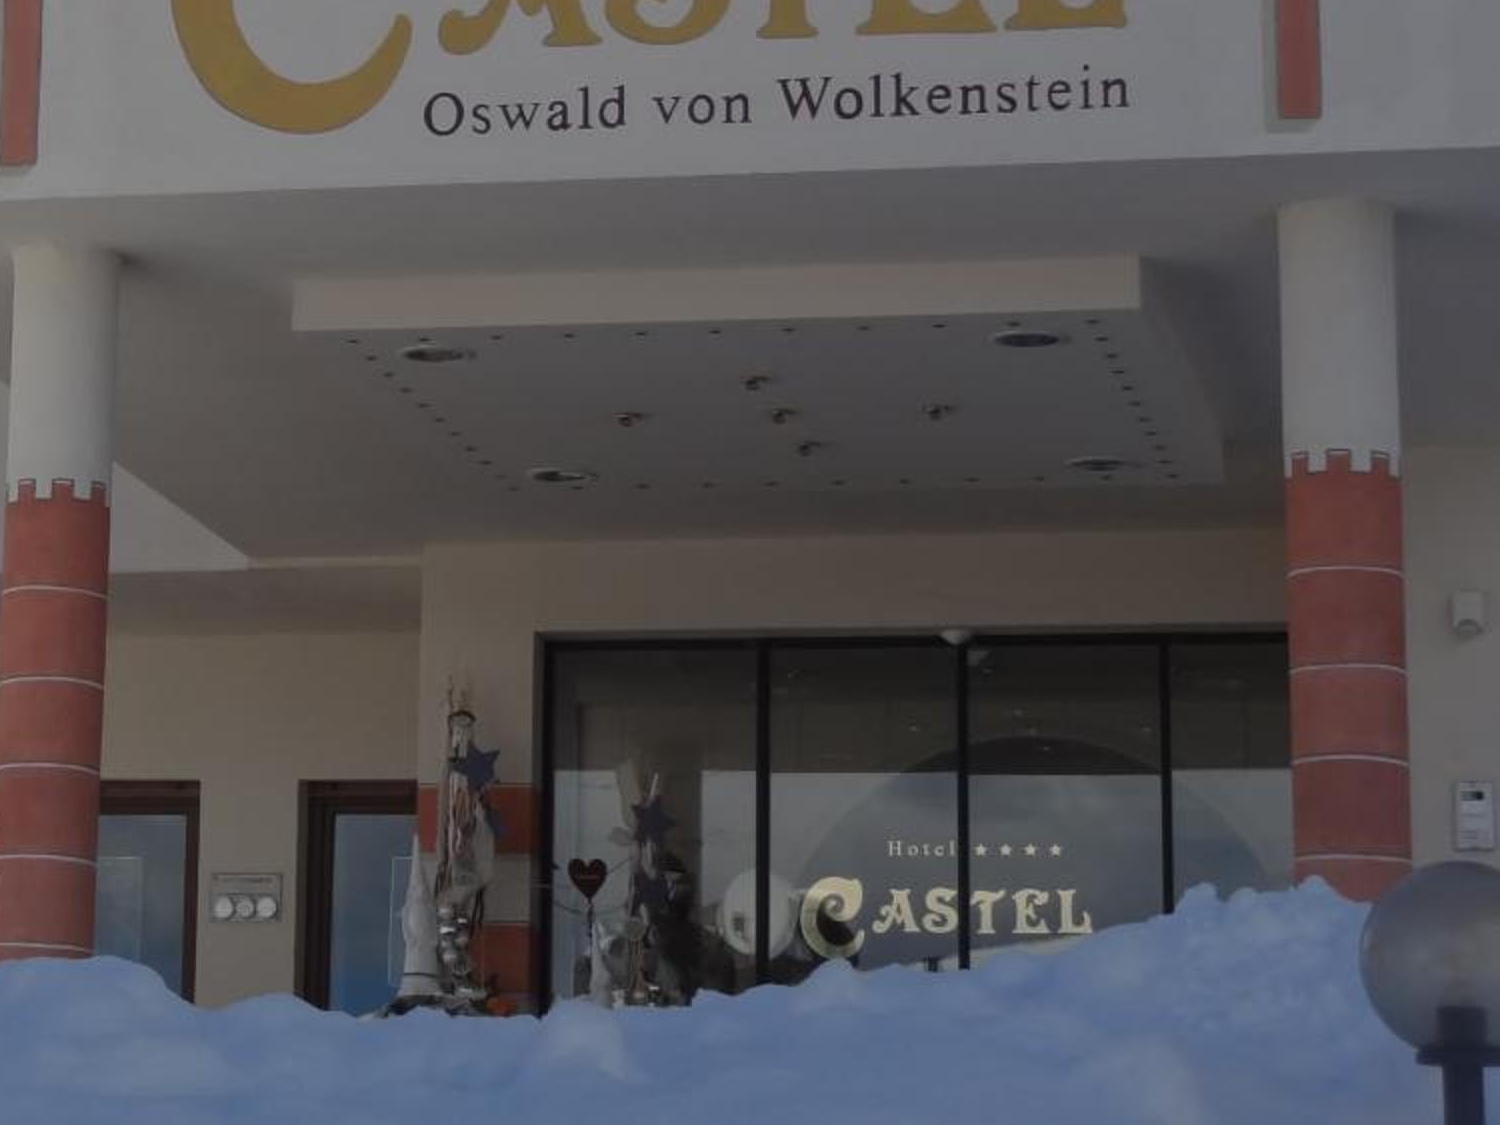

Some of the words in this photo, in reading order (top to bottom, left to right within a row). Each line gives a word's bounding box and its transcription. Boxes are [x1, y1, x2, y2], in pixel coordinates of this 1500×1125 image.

[422, 84, 627, 137] Oswald
[653, 90, 752, 128] von
[775, 65, 1131, 124] Wolkenstein
[888, 840, 957, 857] Hotel
[801, 876, 1093, 959] CASTEL
